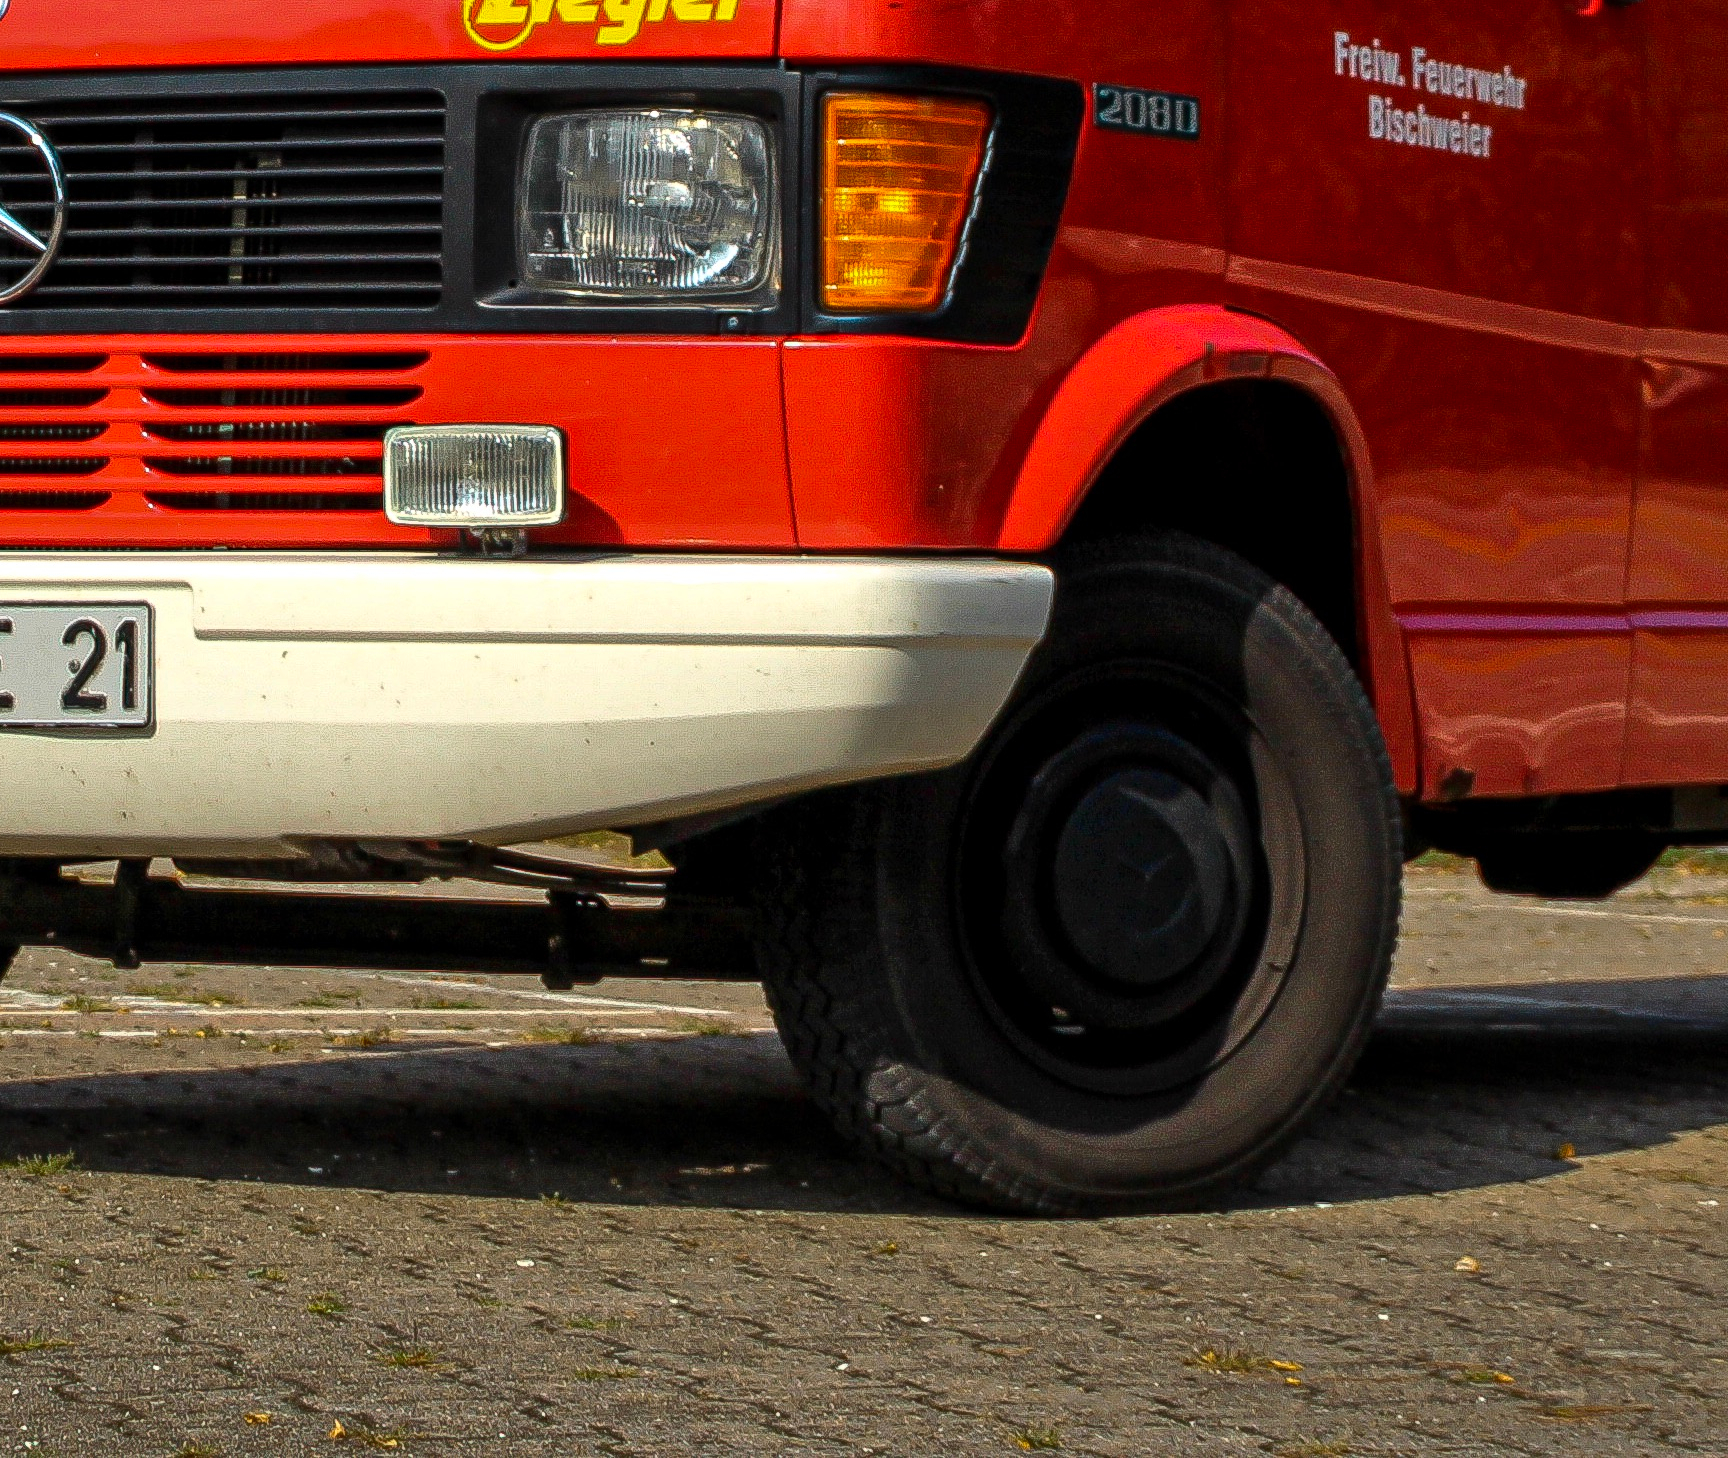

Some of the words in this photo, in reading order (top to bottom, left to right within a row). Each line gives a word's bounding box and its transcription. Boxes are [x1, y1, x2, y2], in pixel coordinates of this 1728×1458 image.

[1334, 31, 1405, 86] Freiw.
[1411, 47, 1527, 109] Feuerwehr
[1368, 94, 1492, 158] Bischweier
[62, 617, 139, 710] 21
